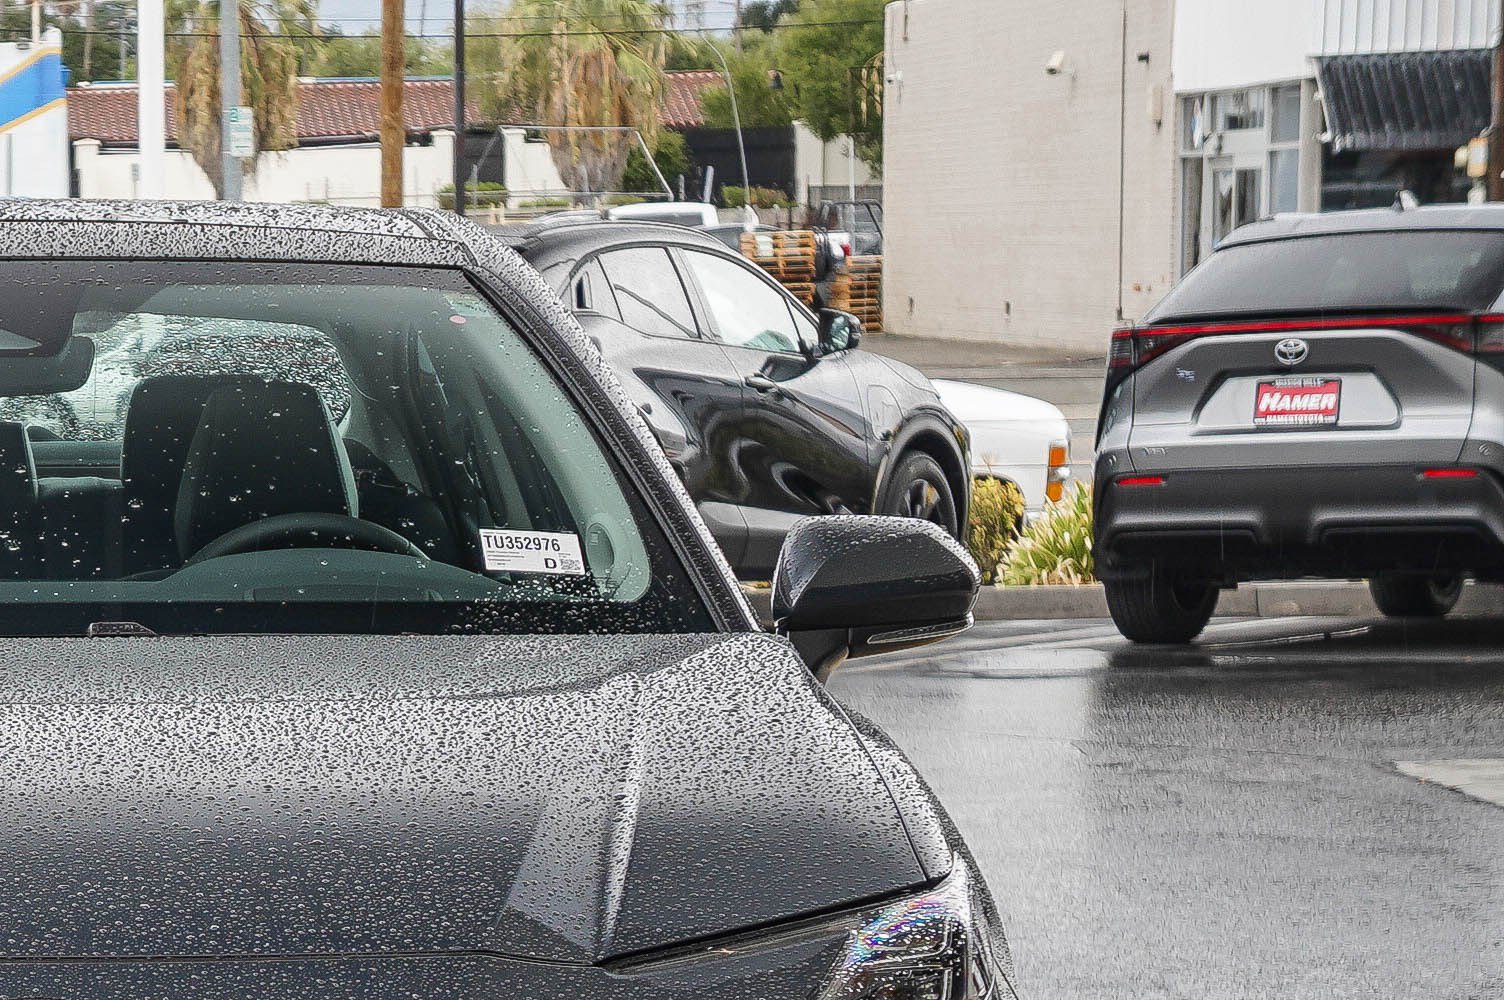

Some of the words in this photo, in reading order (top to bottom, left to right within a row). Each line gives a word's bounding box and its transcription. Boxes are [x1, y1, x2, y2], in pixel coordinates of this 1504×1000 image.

[1258, 392, 1337, 412] HAMER
[483, 534, 561, 552] TU352976
[544, 558, 557, 569] D
